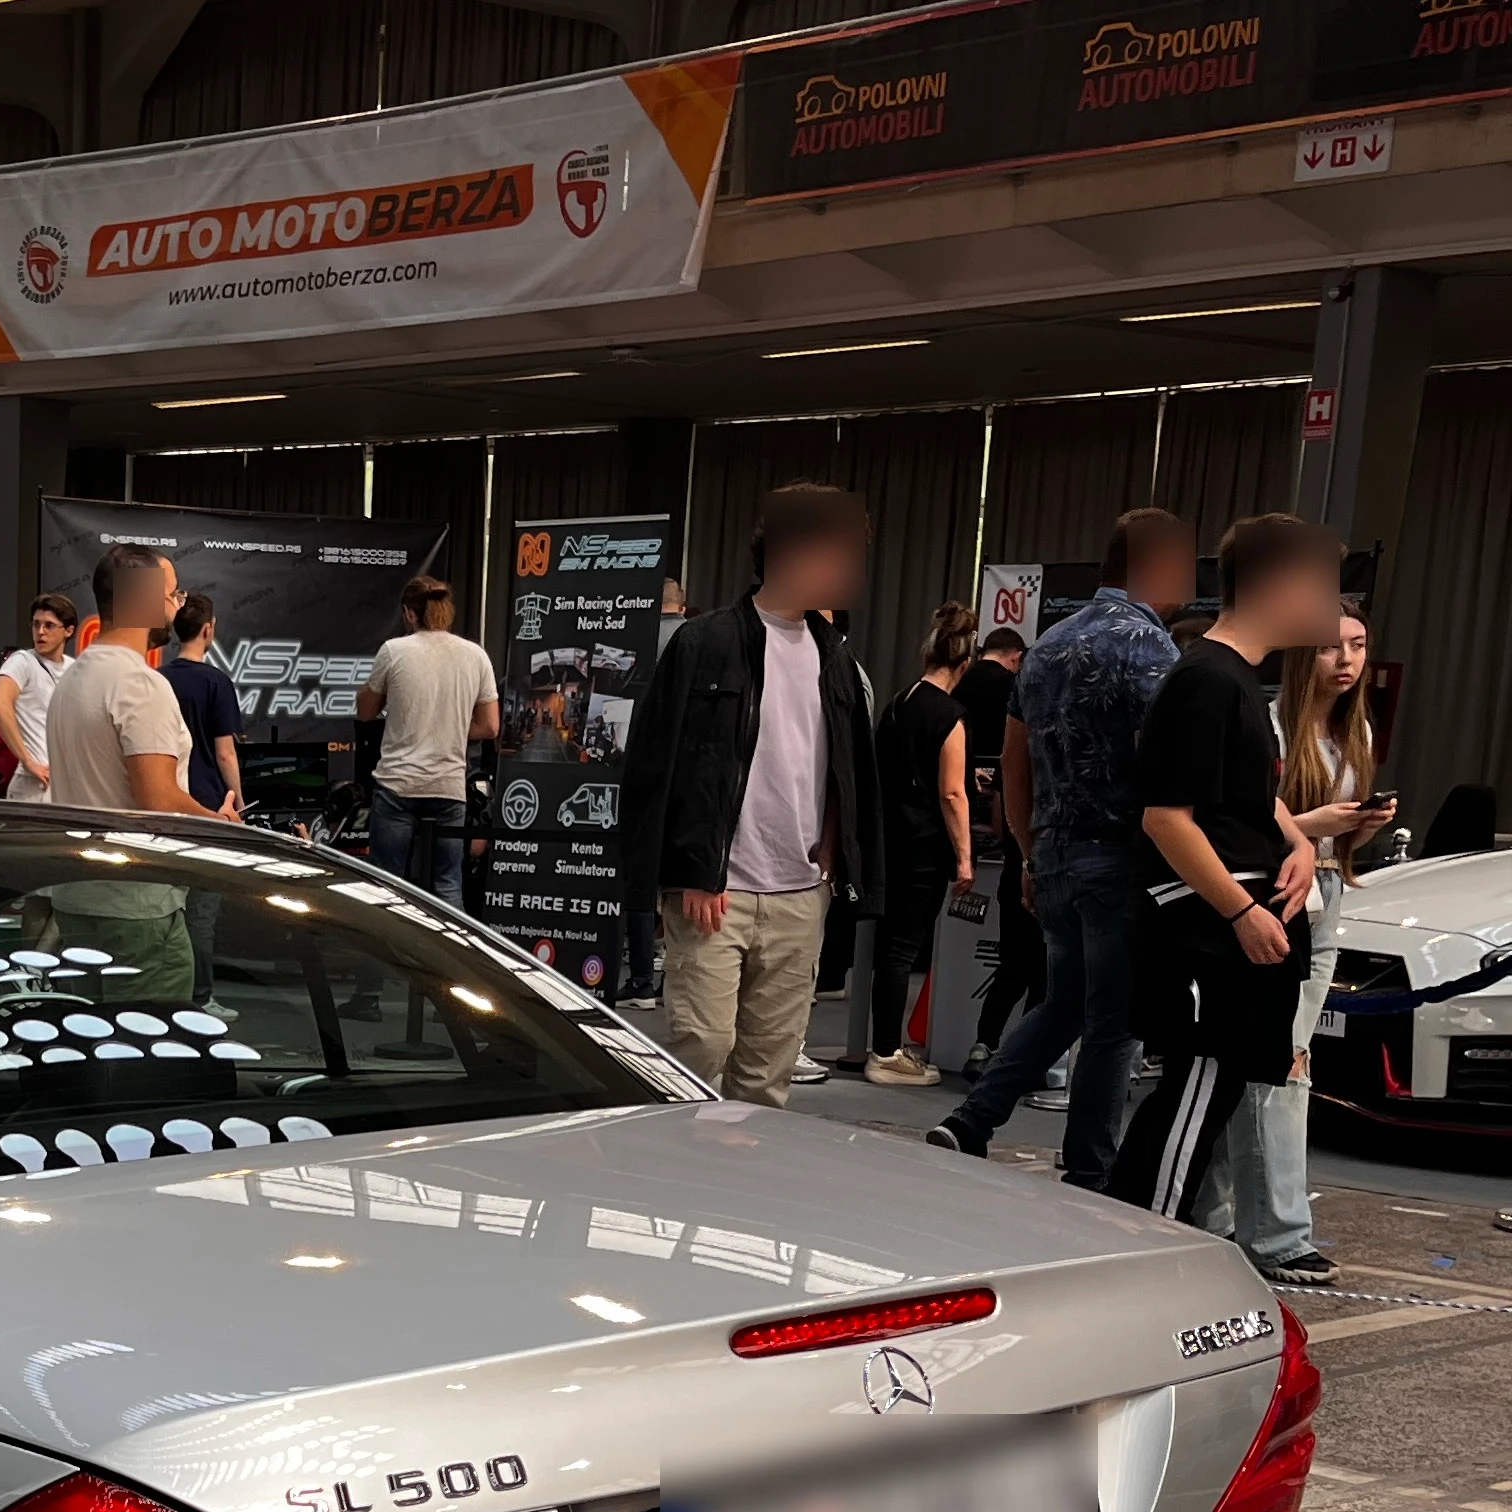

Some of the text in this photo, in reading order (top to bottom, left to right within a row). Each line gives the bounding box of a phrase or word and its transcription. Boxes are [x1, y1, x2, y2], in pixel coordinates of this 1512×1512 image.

[1157, 17, 1261, 60] POLOVNI
[859, 72, 948, 111] POLOVNI
[1077, 52, 1257, 112] AUTOMOBILI
[791, 106, 944, 157] AUTOMOBILI
[96, 217, 223, 271] AUTO
[168, 259, 438, 306] www.automotoberza.com
[1308, 395, 1332, 421] H
[203, 539, 302, 554] WWW.NSPEED.RS
[593, 554, 661, 570] RACING
[554, 594, 655, 613] Sim Racing Centar
[577, 614, 627, 631] Novi Sad
[494, 839, 539, 857] Prodaja
[492, 860, 537, 875] opreme
[554, 858, 616, 878] Simulatora
[485, 890, 622, 917] THE RACE IS ON
[564, 930, 583, 940] Novi
[583, 931, 598, 942] Sad
[386, 1453, 528, 1508] 500
